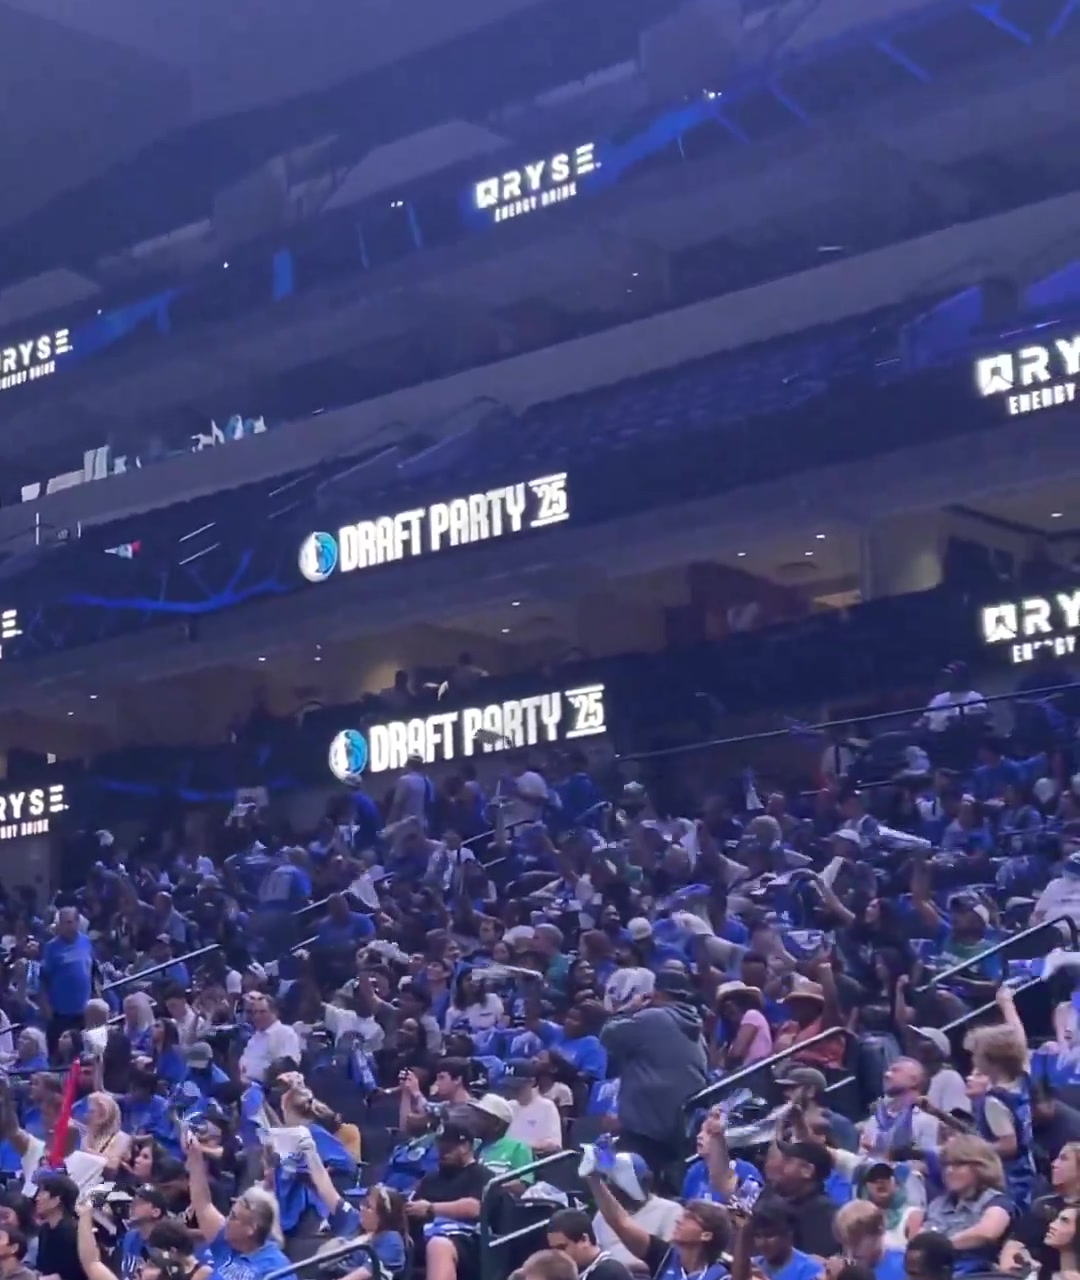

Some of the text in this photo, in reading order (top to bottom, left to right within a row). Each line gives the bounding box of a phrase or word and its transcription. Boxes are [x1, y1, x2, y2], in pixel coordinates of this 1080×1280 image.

[339, 508, 427, 572] DRAFT
[429, 482, 527, 551] PARTY
[370, 712, 459, 773] DRAFT
[462, 691, 562, 757] PARTY
